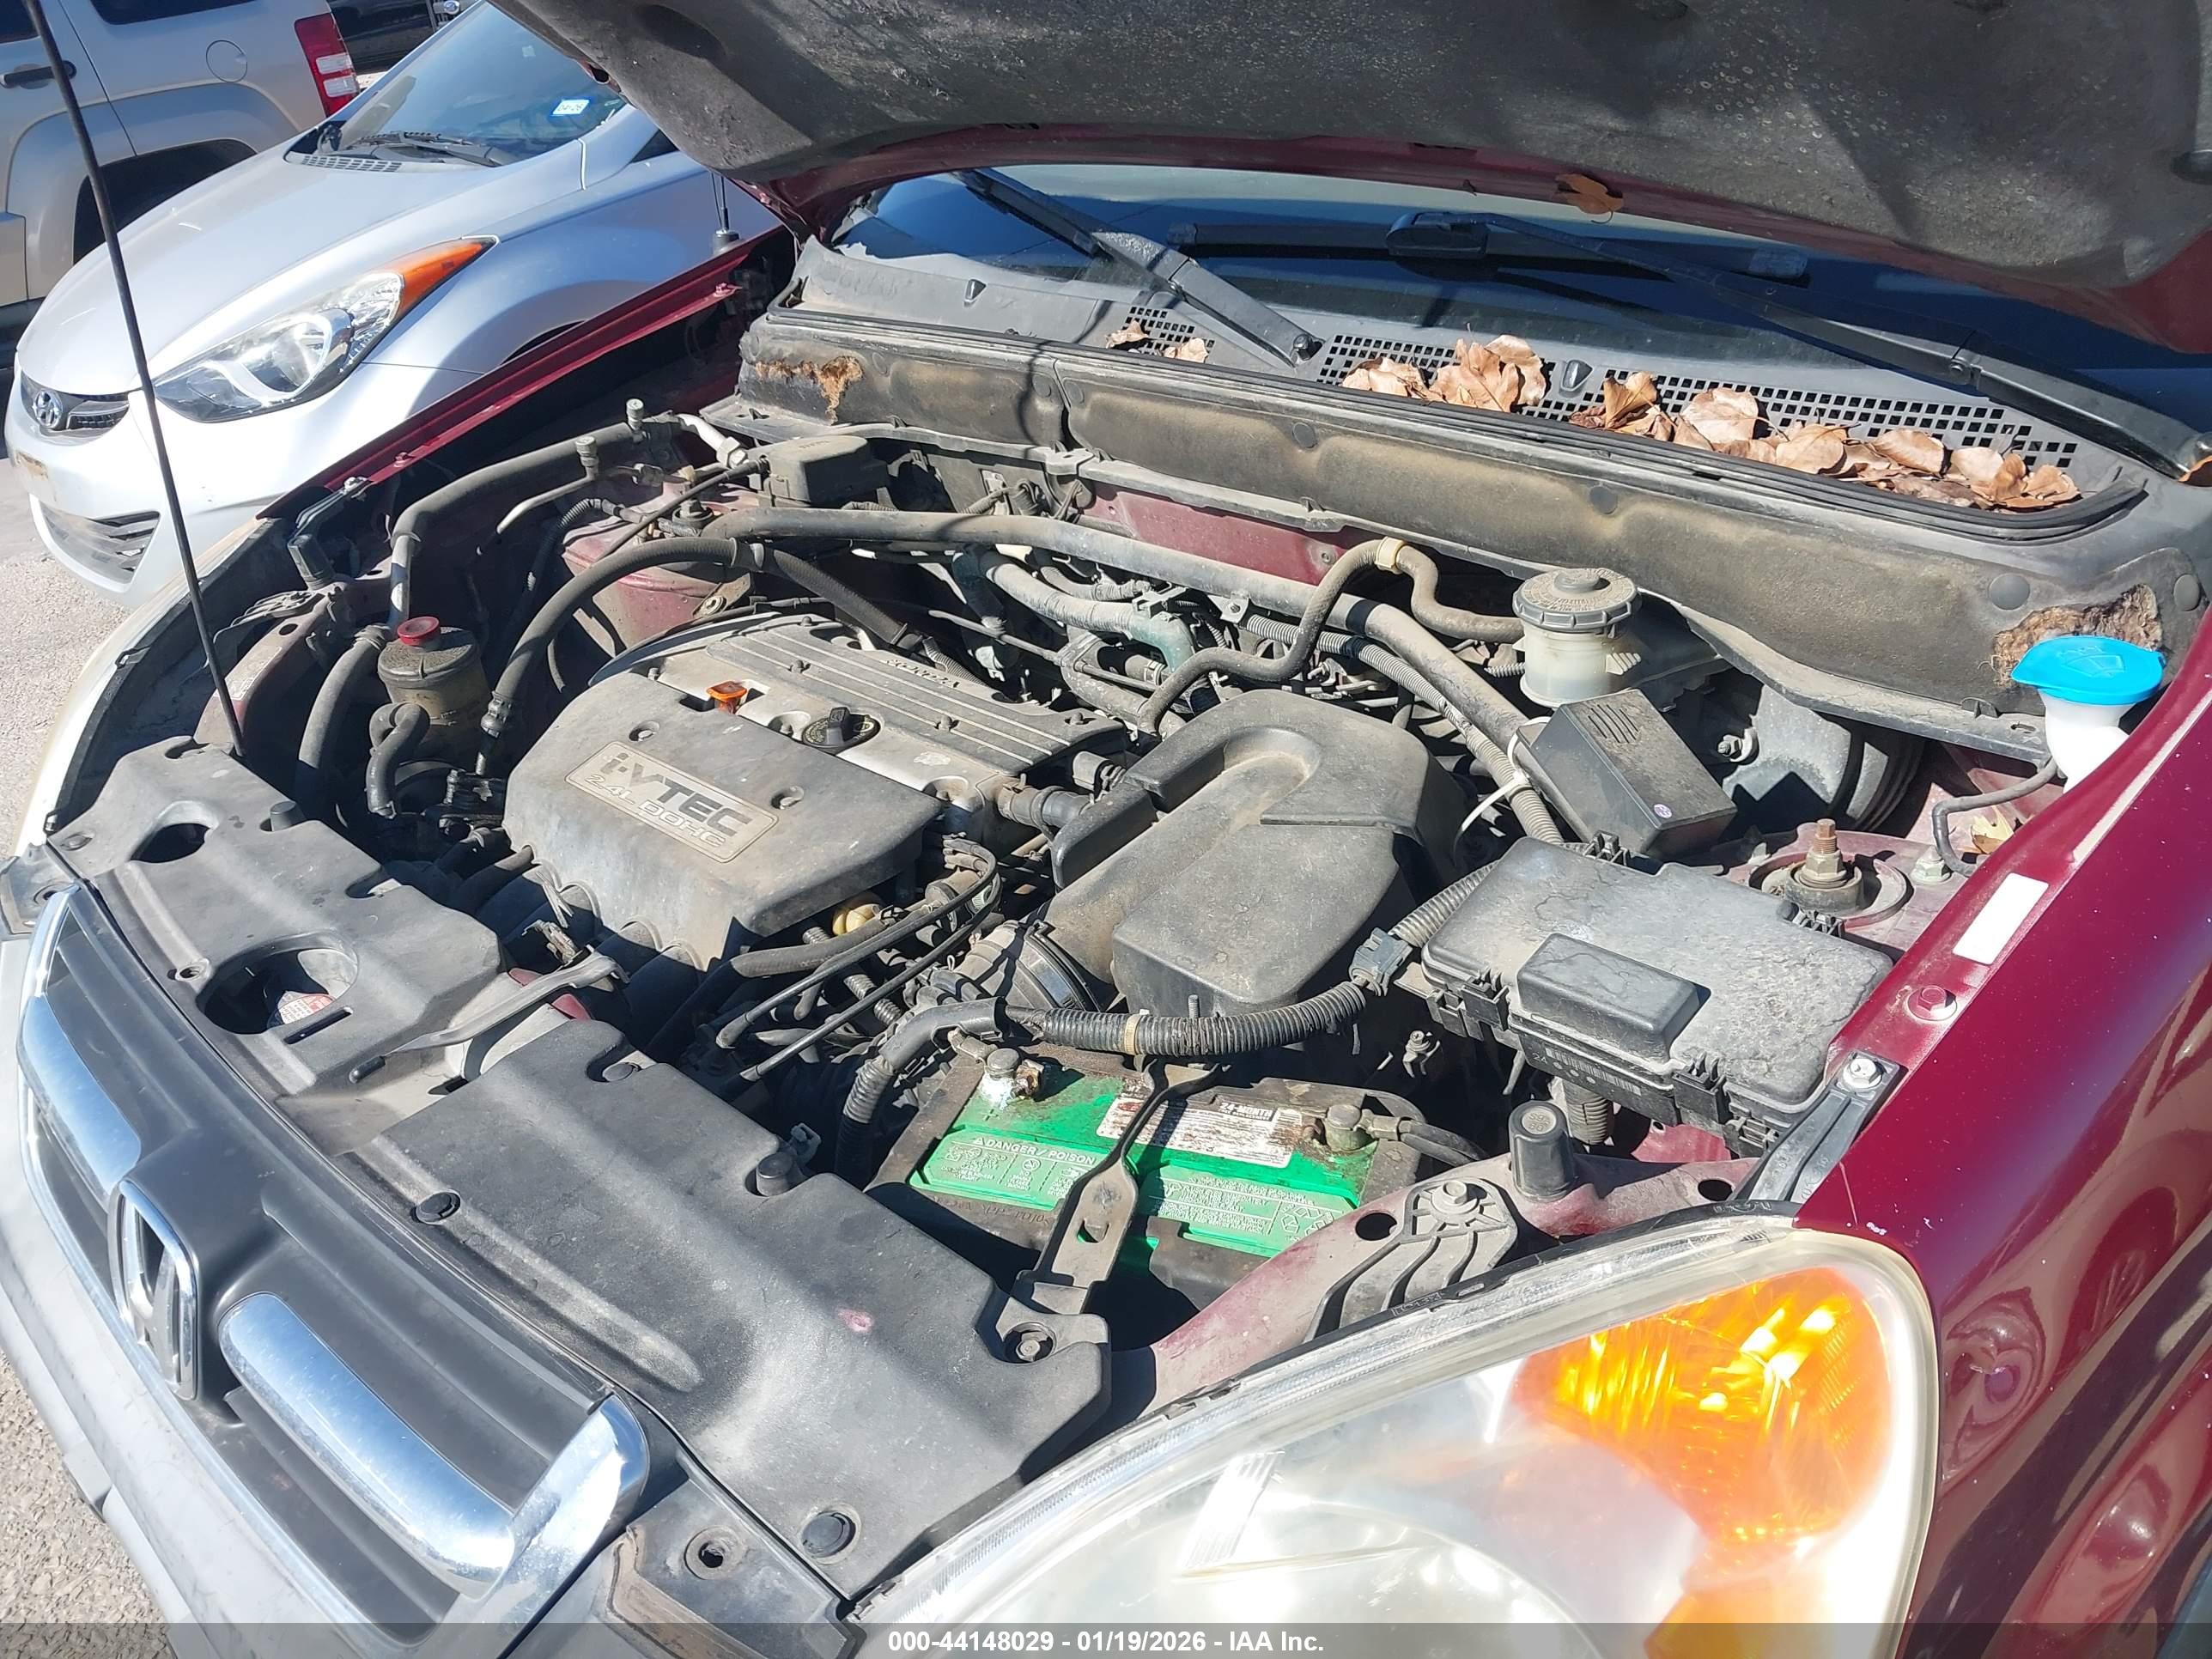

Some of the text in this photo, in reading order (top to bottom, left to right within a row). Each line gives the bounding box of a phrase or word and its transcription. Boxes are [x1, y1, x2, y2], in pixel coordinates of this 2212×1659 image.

[585, 775, 726, 847] 2.4L DOHC
[600, 752, 752, 836] i-VTEC
[1219, 1103, 1273, 1117] 24-MONTH
[1048, 1150, 1095, 1165] POISON
